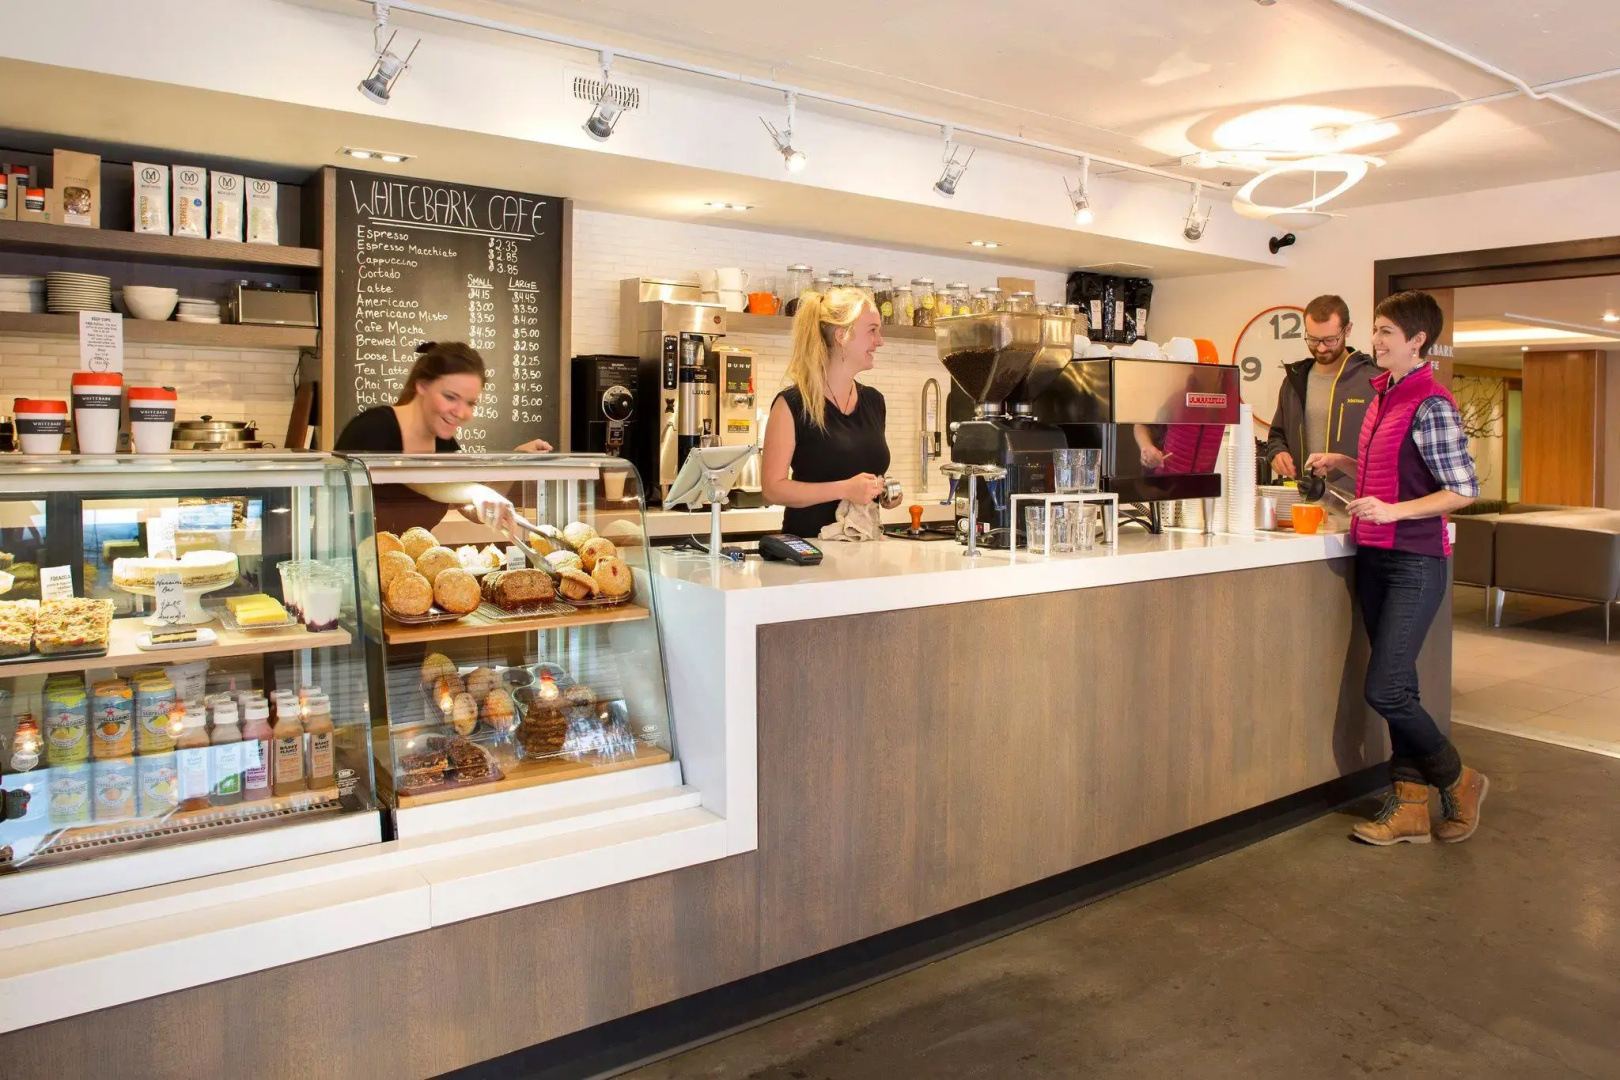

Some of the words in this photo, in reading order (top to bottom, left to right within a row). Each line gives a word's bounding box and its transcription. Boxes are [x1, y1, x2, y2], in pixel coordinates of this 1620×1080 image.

[350, 180, 477, 228] WHITEBARK
[488, 195, 547, 236] CAFE
[357, 225, 409, 242] Espresso
[357, 239, 405, 252] Espresso
[408, 244, 458, 258] Macchiato
[488, 237, 518, 253] $2.35
[356, 251, 418, 267] Cappuccino
[488, 249, 518, 263] $2.85
[358, 265, 401, 279] Cortado
[488, 260, 519, 275] $3.85
[357, 278, 394, 293] Latte
[356, 293, 419, 308] Americano
[512, 291, 536, 304] $4.45
[355, 306, 416, 320] Americano
[418, 311, 449, 322] Misto
[512, 304, 539, 314] $3.50
[469, 312, 495, 323] $3.50
[512, 315, 538, 325] $4.00
[355, 320, 384, 333] Cafe
[388, 320, 426, 335] Mocha
[469, 325, 496, 338] $4.50
[512, 328, 540, 339] $5.00
[1269, 313, 1301, 340] 12
[356, 334, 397, 347] Brewed
[469, 338, 496, 350] $2.00
[513, 340, 540, 352] $2.50
[356, 348, 389, 361] Loose
[354, 363, 377, 375] Tea
[381, 363, 409, 376] Latte
[512, 367, 542, 380] $3.50
[1241, 357, 1262, 382] 9
[355, 377, 381, 390] Chai
[513, 382, 543, 393] $4.50
[356, 391, 378, 404] Hot
[512, 394, 543, 407] $5.00
[512, 408, 542, 423] $3.00
[456, 426, 487, 440] $0.50
